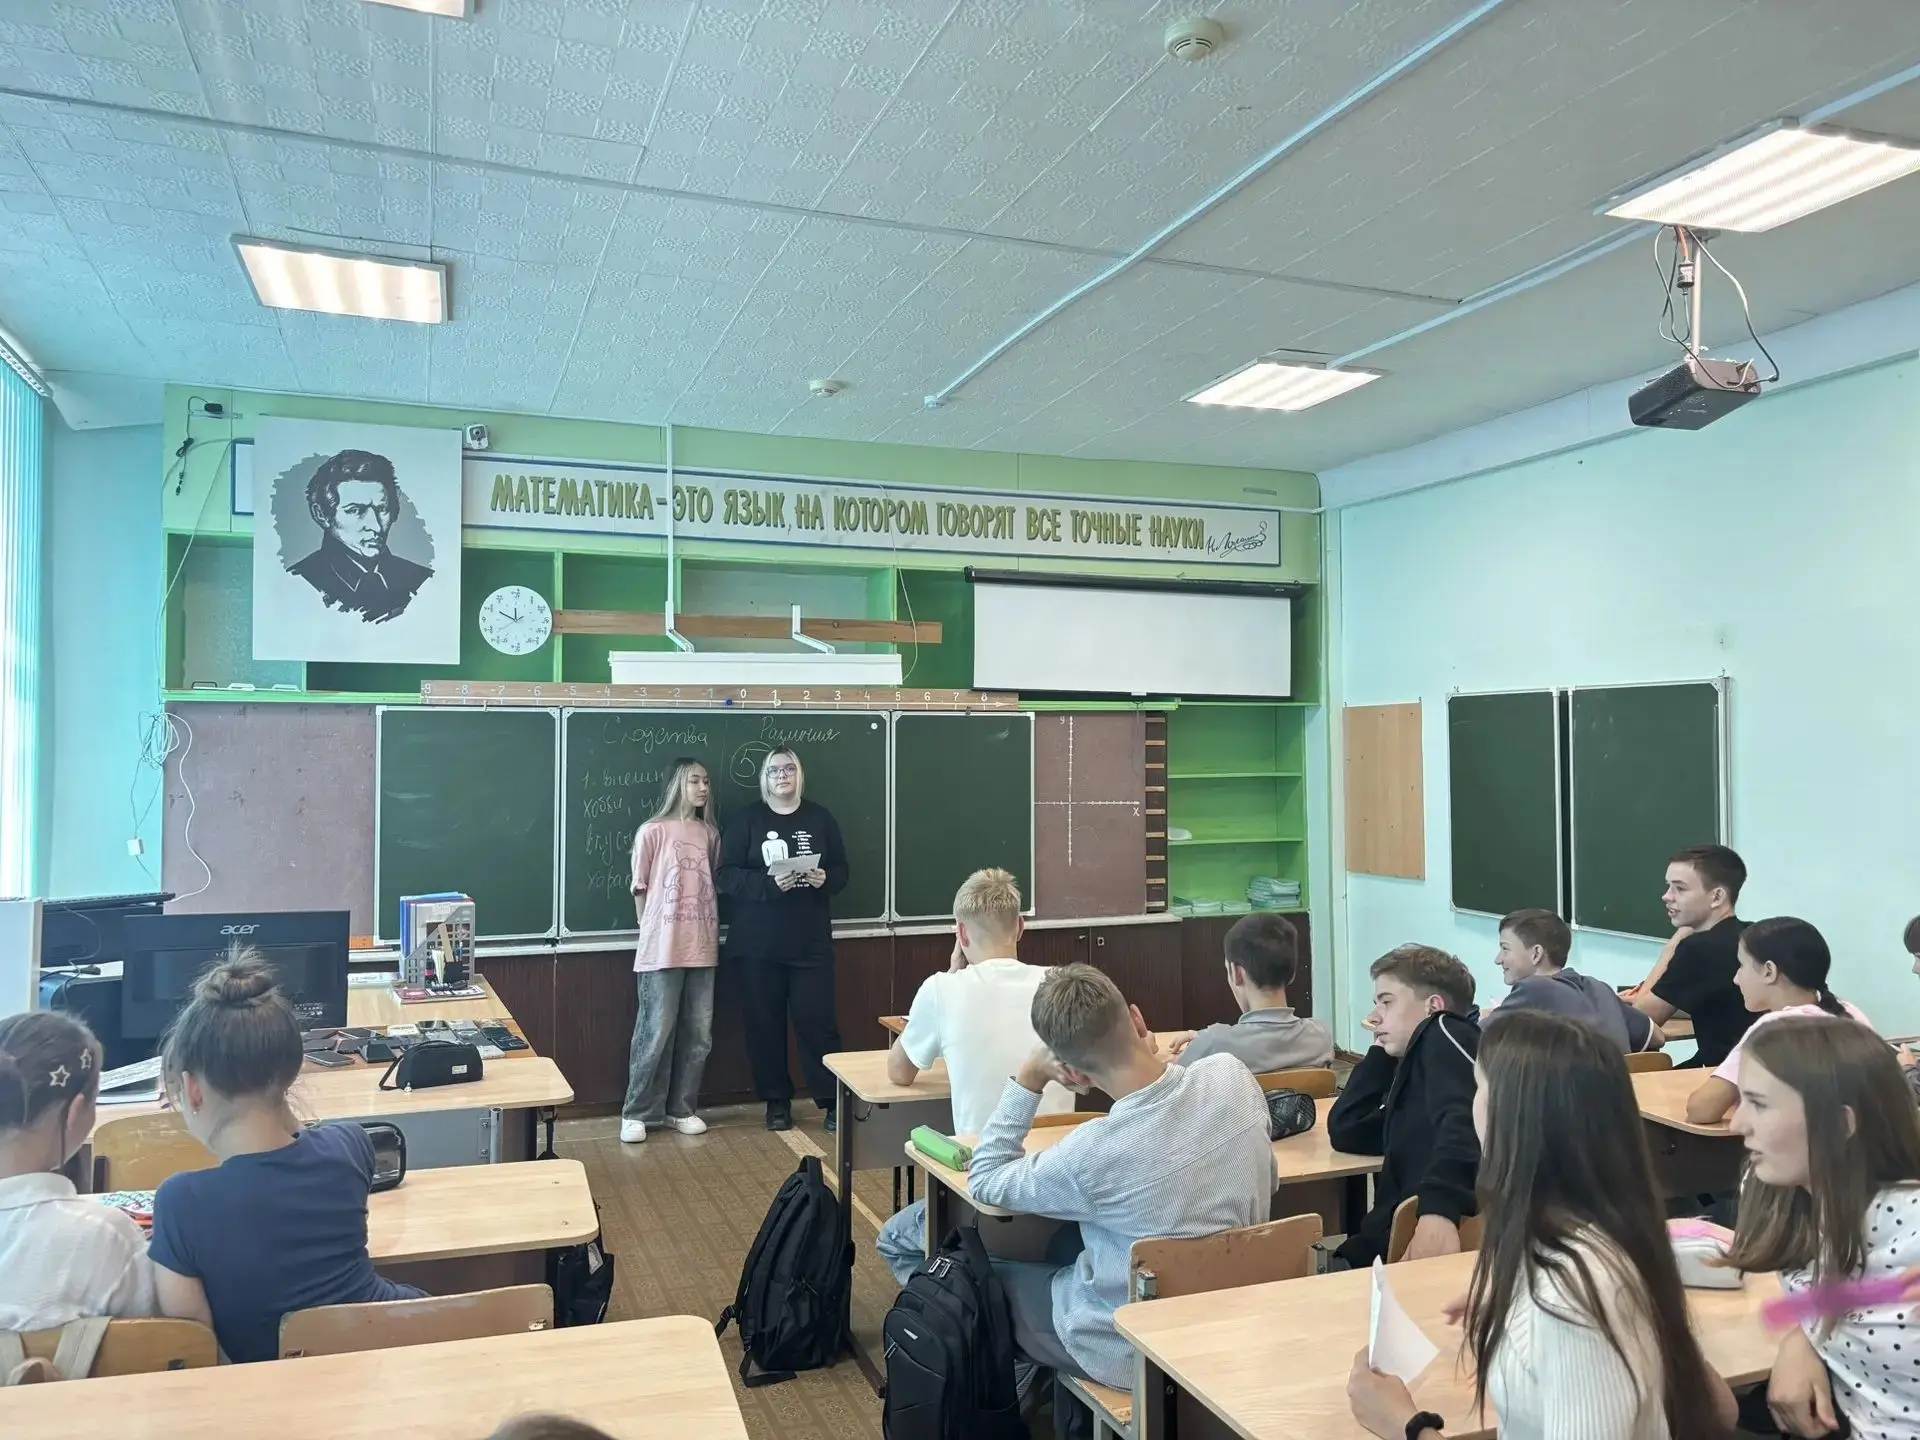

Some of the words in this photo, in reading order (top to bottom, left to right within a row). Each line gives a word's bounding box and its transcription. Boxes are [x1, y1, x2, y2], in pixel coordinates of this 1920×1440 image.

[795, 494, 825, 531] НА
[834, 496, 929, 536] КОТОРОМ
[936, 502, 1017, 540] ГОВОРЯТ
[1026, 507, 1062, 542] ВСЕ
[1070, 510, 1143, 546] ТОЧНЫЕ
[1148, 515, 1205, 550] НАУКИ
[740, 688, 747, 698] 0
[771, 688, 778, 700] 1
[803, 690, 811, 700] 2
[834, 690, 841, 701] 3
[864, 690, 871, 701] 4
[895, 691, 901, 701] 5
[924, 691, 931, 702] 6
[952, 691, 960, 702] 7
[980, 691, 988, 702] 8
[604, 715, 708, 754] Сходства
[603, 767, 665, 787] внешн
[220, 924, 260, 935] acer
